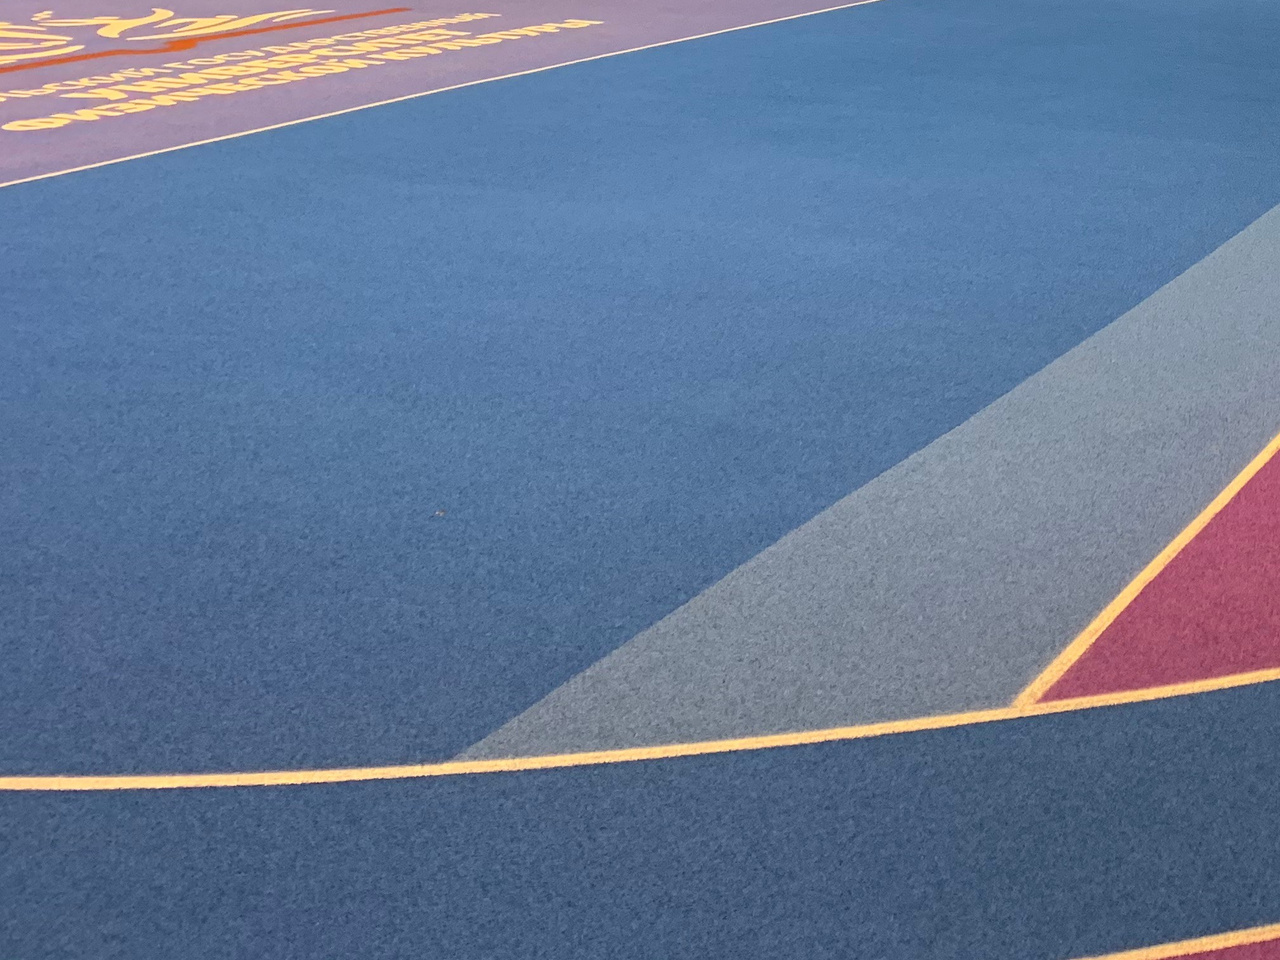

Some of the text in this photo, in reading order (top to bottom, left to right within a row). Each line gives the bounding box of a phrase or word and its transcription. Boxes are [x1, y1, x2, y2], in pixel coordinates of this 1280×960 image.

[1, 18, 604, 131] ФИЗИЧЕСКОЙ КУЛЬТУРЫ
[60, 28, 471, 101] УНИВЕРСИТЕТ
[162, 13, 501, 69] ГОСУДАРСТВЕННЫЙ
